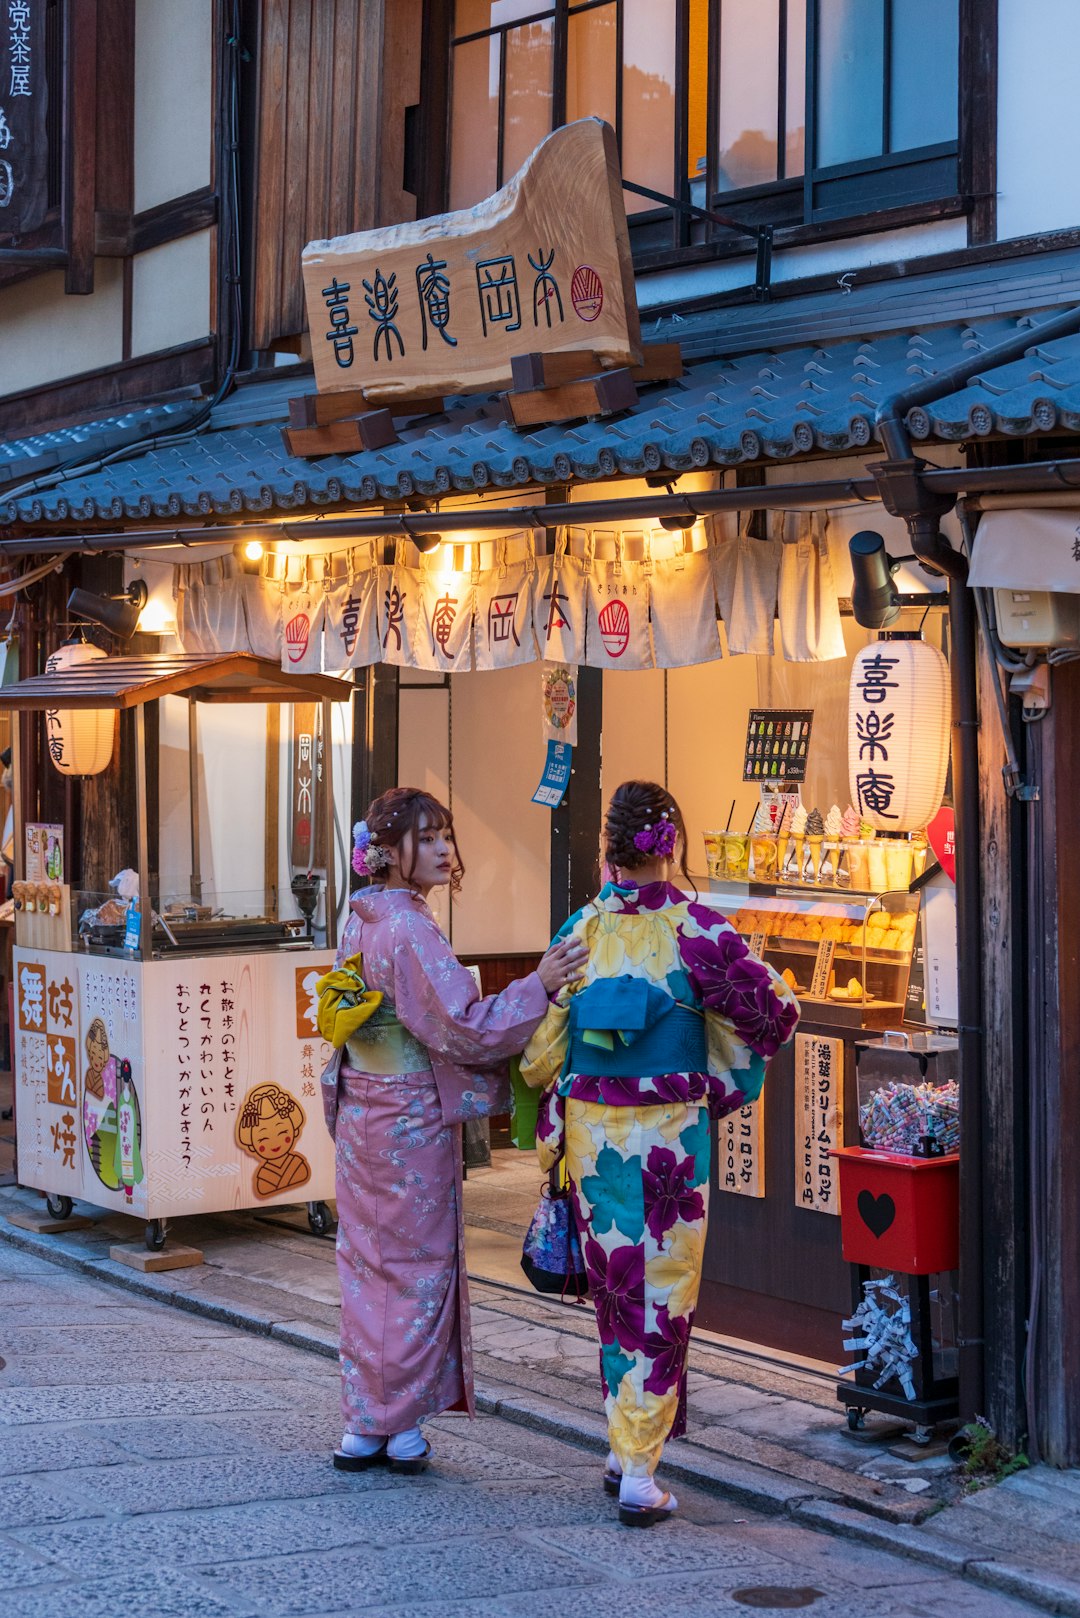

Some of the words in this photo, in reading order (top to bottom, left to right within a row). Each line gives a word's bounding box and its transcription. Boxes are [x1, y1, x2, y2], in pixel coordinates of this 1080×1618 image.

[220, 980, 236, 1112] お散歩のおともに
[725, 1121, 736, 1187] 300円
[802, 1136, 814, 1204] 250円
